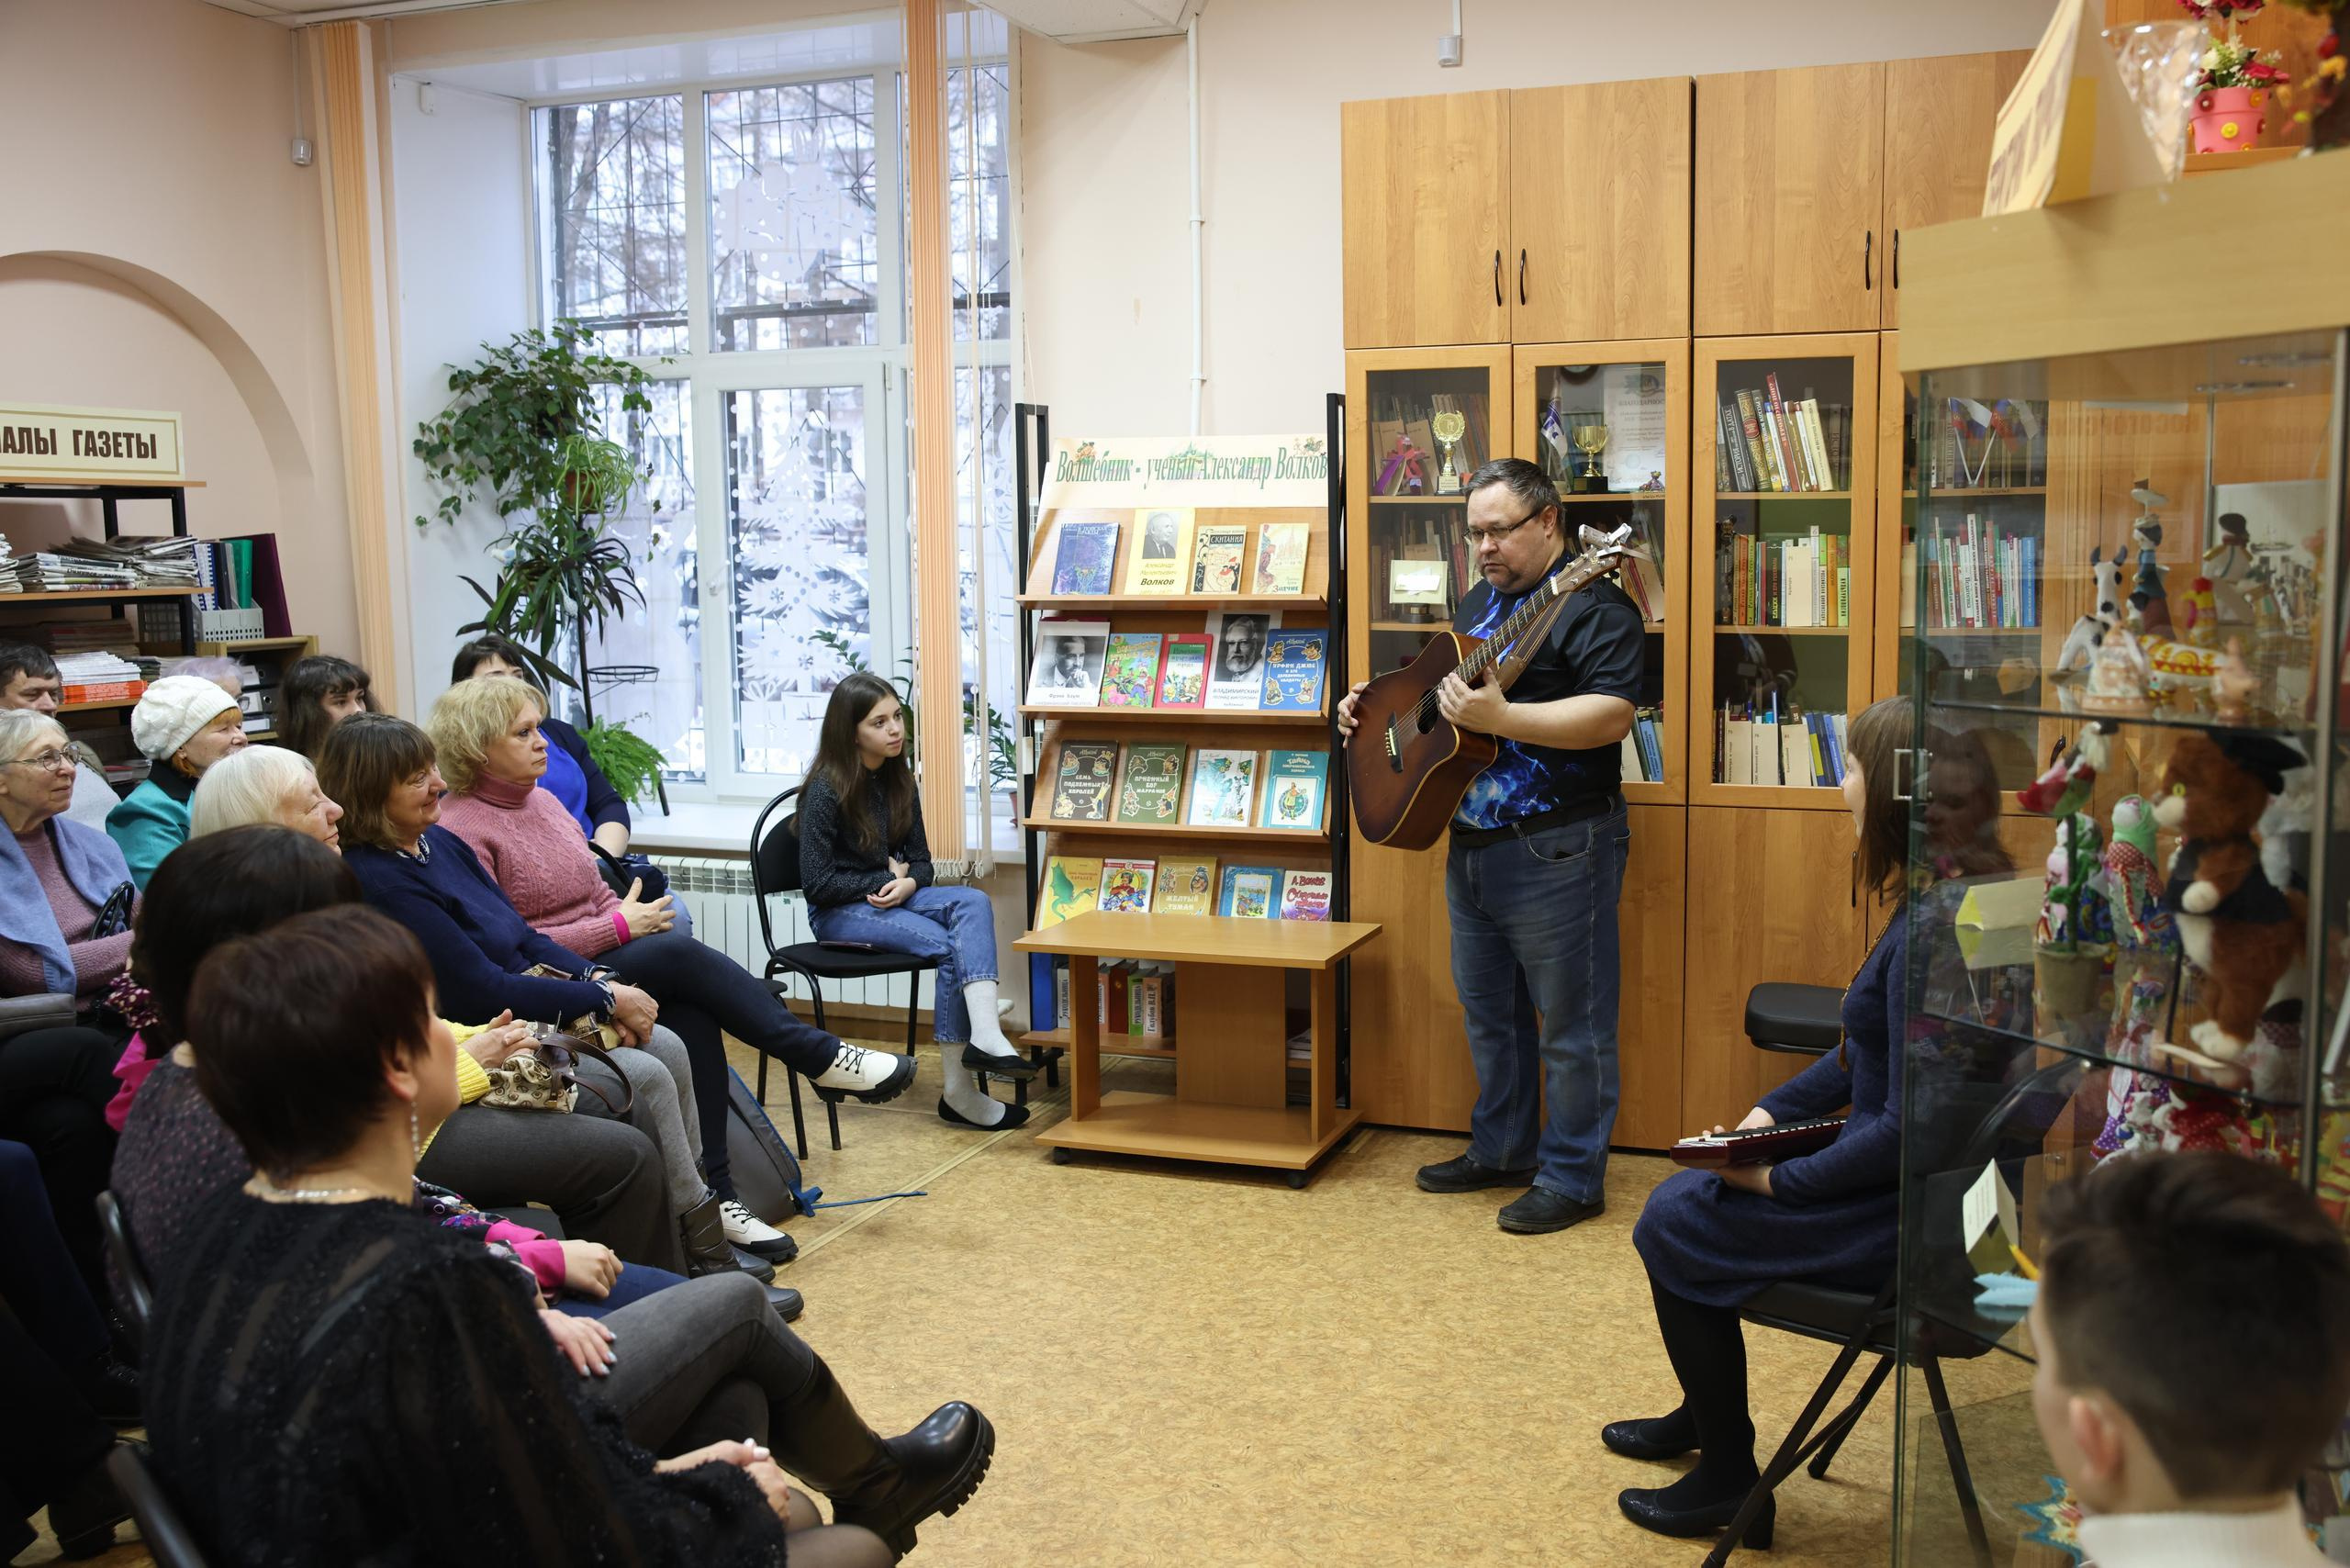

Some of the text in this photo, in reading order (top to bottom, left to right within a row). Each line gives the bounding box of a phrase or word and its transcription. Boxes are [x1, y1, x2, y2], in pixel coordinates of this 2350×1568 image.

[1726, 409, 1736, 427] ДАТАХ
[0, 426, 157, 459] АЛЫ ГАЗЕТЫ
[1056, 450, 1134, 483] Волшебник
[1143, 453, 1194, 490] ученый
[1197, 449, 1272, 489] Александр
[1274, 446, 1328, 480] Волков
[1733, 447, 1743, 474] ИСТОРИЯ
[1211, 535, 1244, 543] СКИТАНИЯ
